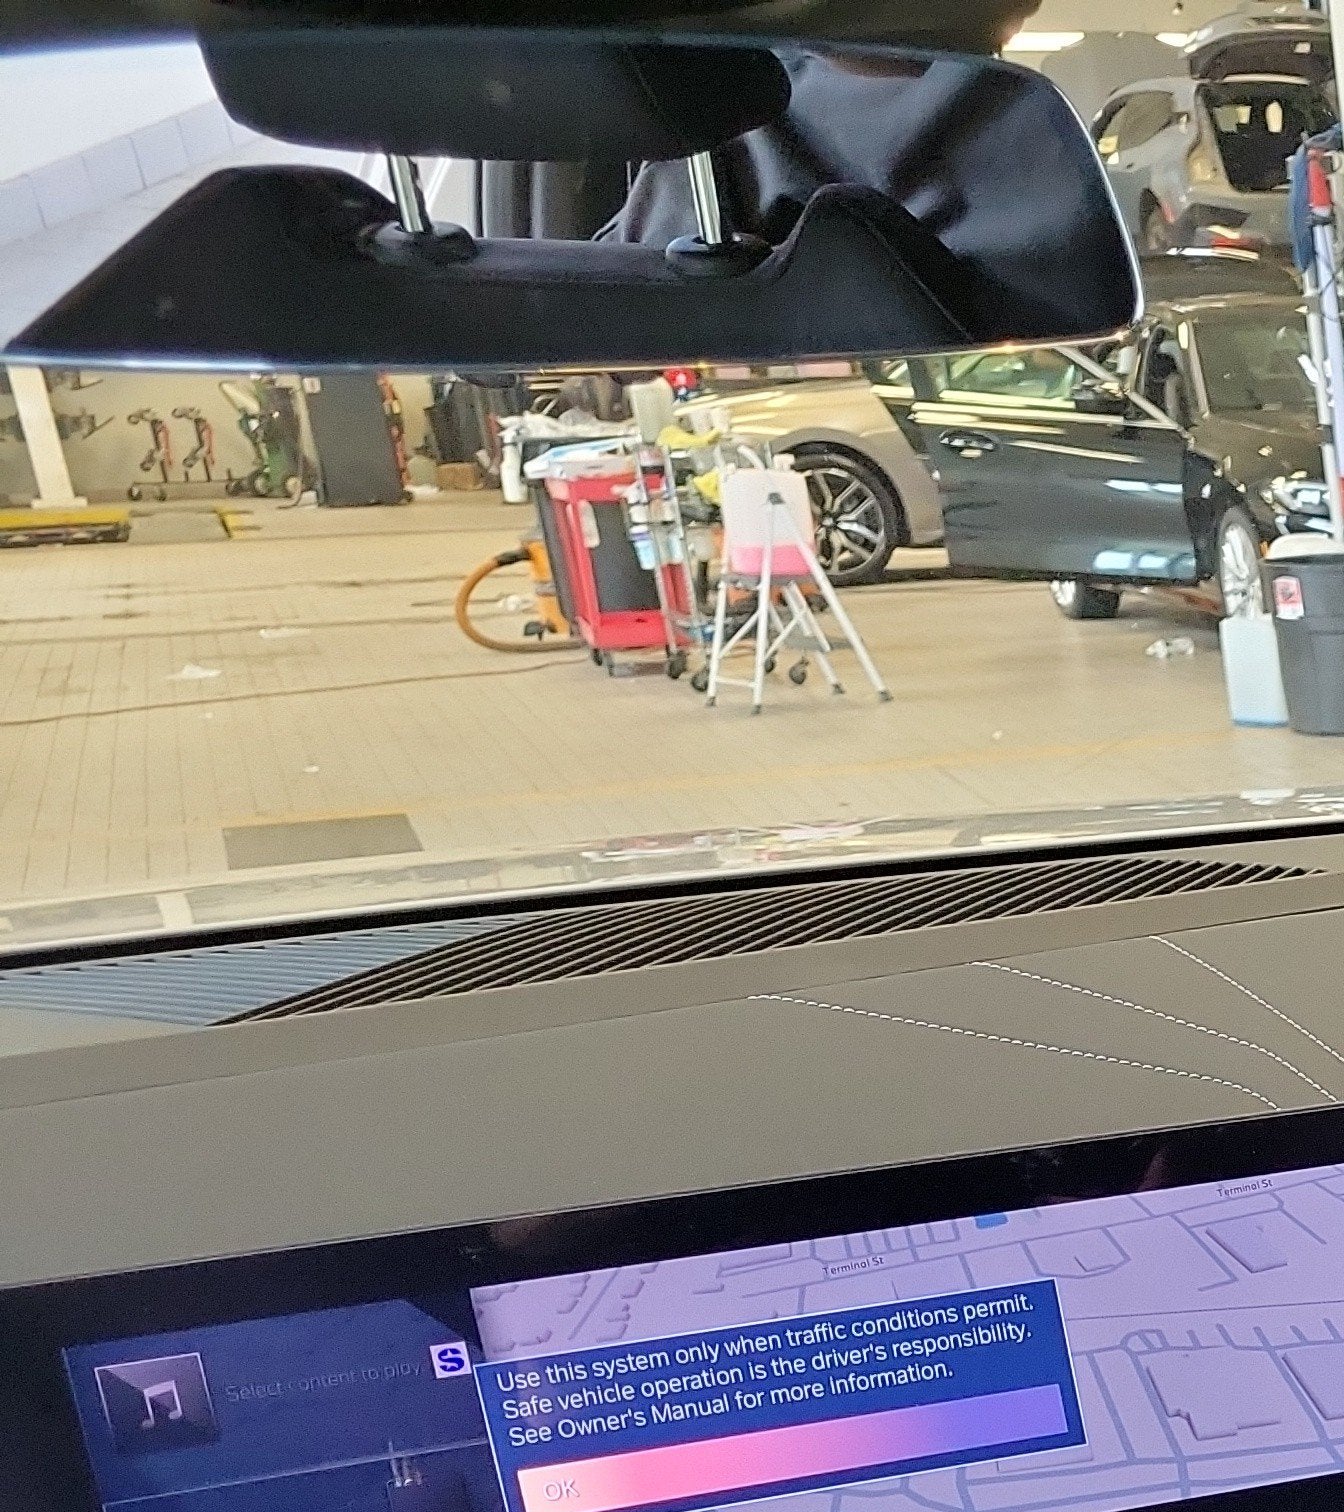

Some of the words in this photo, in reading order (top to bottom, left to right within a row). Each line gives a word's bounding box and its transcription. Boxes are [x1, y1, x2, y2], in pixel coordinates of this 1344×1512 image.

[1216, 1180, 1261, 1198] Terminal
[1261, 1178, 1274, 1189] St
[821, 1258, 871, 1276] Terminal
[871, 1256, 885, 1267] St
[496, 1370, 541, 1392] Use
[545, 1361, 588, 1385] this
[592, 1350, 671, 1379] system
[674, 1339, 720, 1364] only
[723, 1333, 782, 1357] when
[785, 1321, 847, 1348] traffic
[850, 1305, 959, 1338] conditions
[962, 1292, 1035, 1323] permit.
[502, 1396, 552, 1419] Safe
[557, 1383, 635, 1411] vehicle
[640, 1366, 743, 1400] operation
[748, 1361, 767, 1380] is
[770, 1356, 807, 1377] the
[811, 1343, 888, 1371] driver's
[891, 1322, 1033, 1359] responsibility.
[508, 1425, 552, 1447] See
[557, 1407, 648, 1438] Owner's
[650, 1393, 730, 1424] Manual
[733, 1390, 766, 1411] for
[769, 1381, 825, 1406] more
[829, 1361, 954, 1396] information.
[543, 1478, 581, 1501] OK
